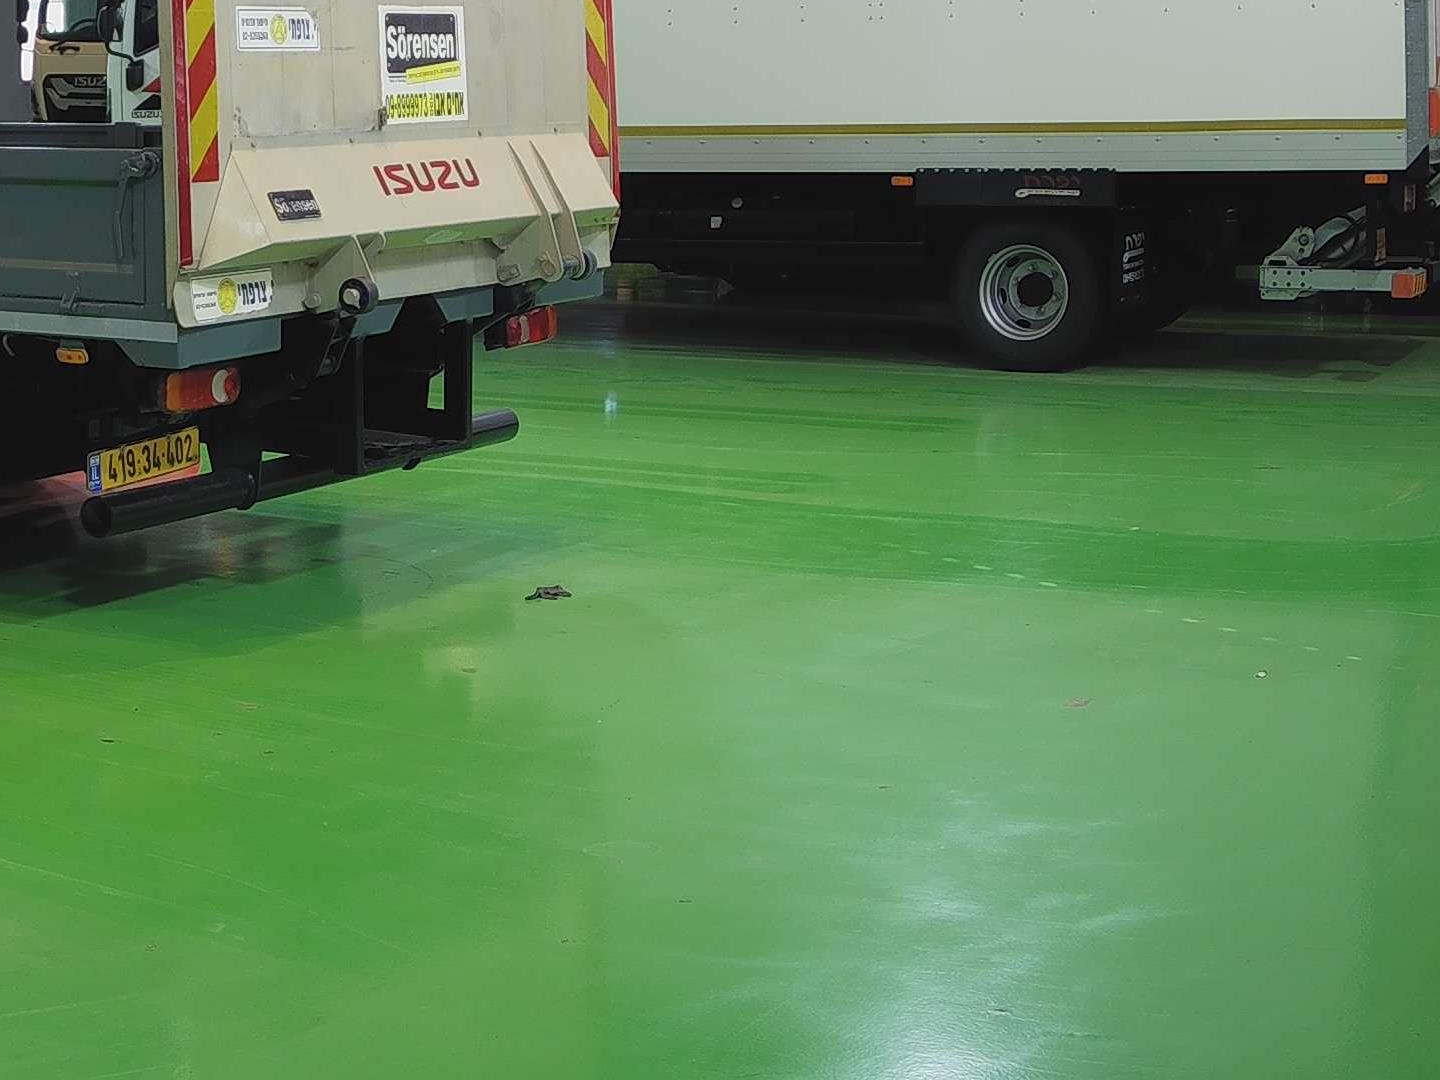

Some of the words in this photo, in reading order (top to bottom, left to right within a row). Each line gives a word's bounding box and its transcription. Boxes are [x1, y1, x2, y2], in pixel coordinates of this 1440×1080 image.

[387, 25, 455, 60] Sörensen
[74, 77, 107, 86] ISUZ
[131, 111, 160, 119] ISUZU
[373, 158, 480, 196] ISUZU
